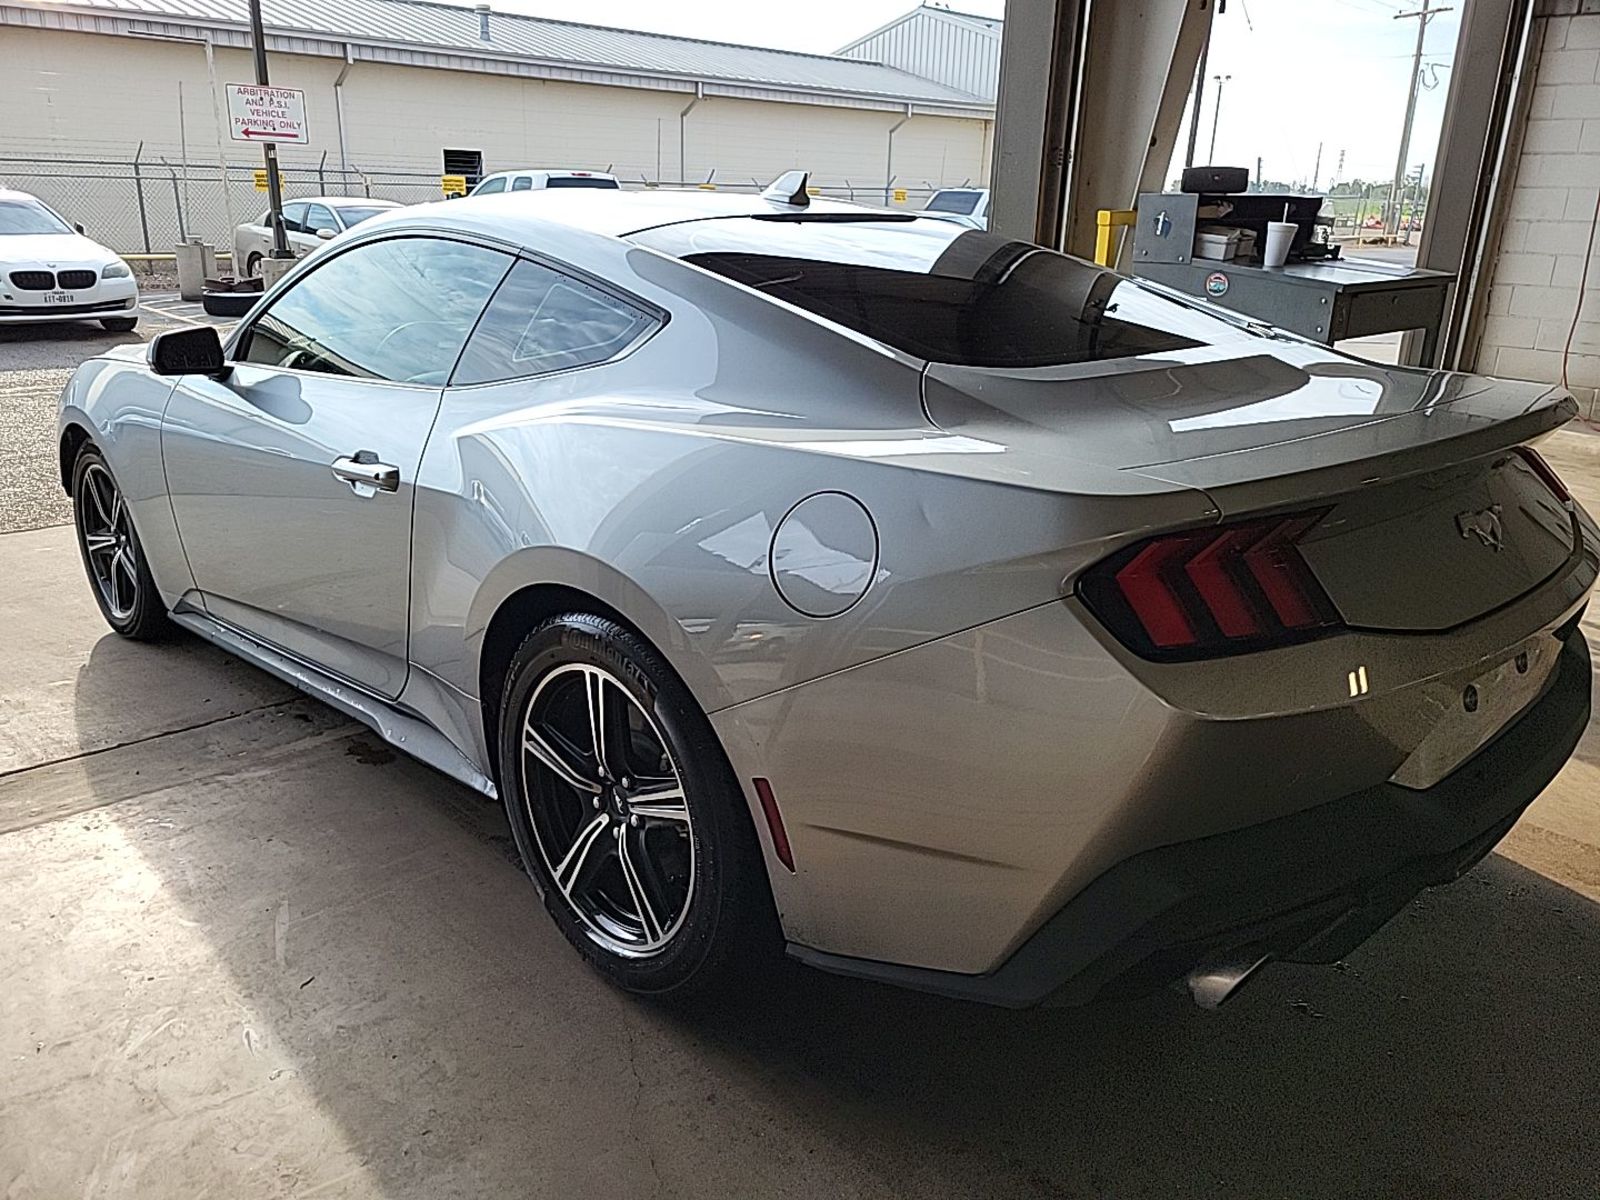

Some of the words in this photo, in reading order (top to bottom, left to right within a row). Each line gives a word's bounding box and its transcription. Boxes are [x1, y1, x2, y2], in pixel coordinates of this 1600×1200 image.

[237, 87, 295, 99] ARBITRATION
[245, 98, 264, 107] AND
[269, 99, 290, 109] P.S.I.
[249, 108, 287, 119] VEHICLE
[234, 117, 276, 128] PARKING
[279, 120, 302, 130] ONLY
